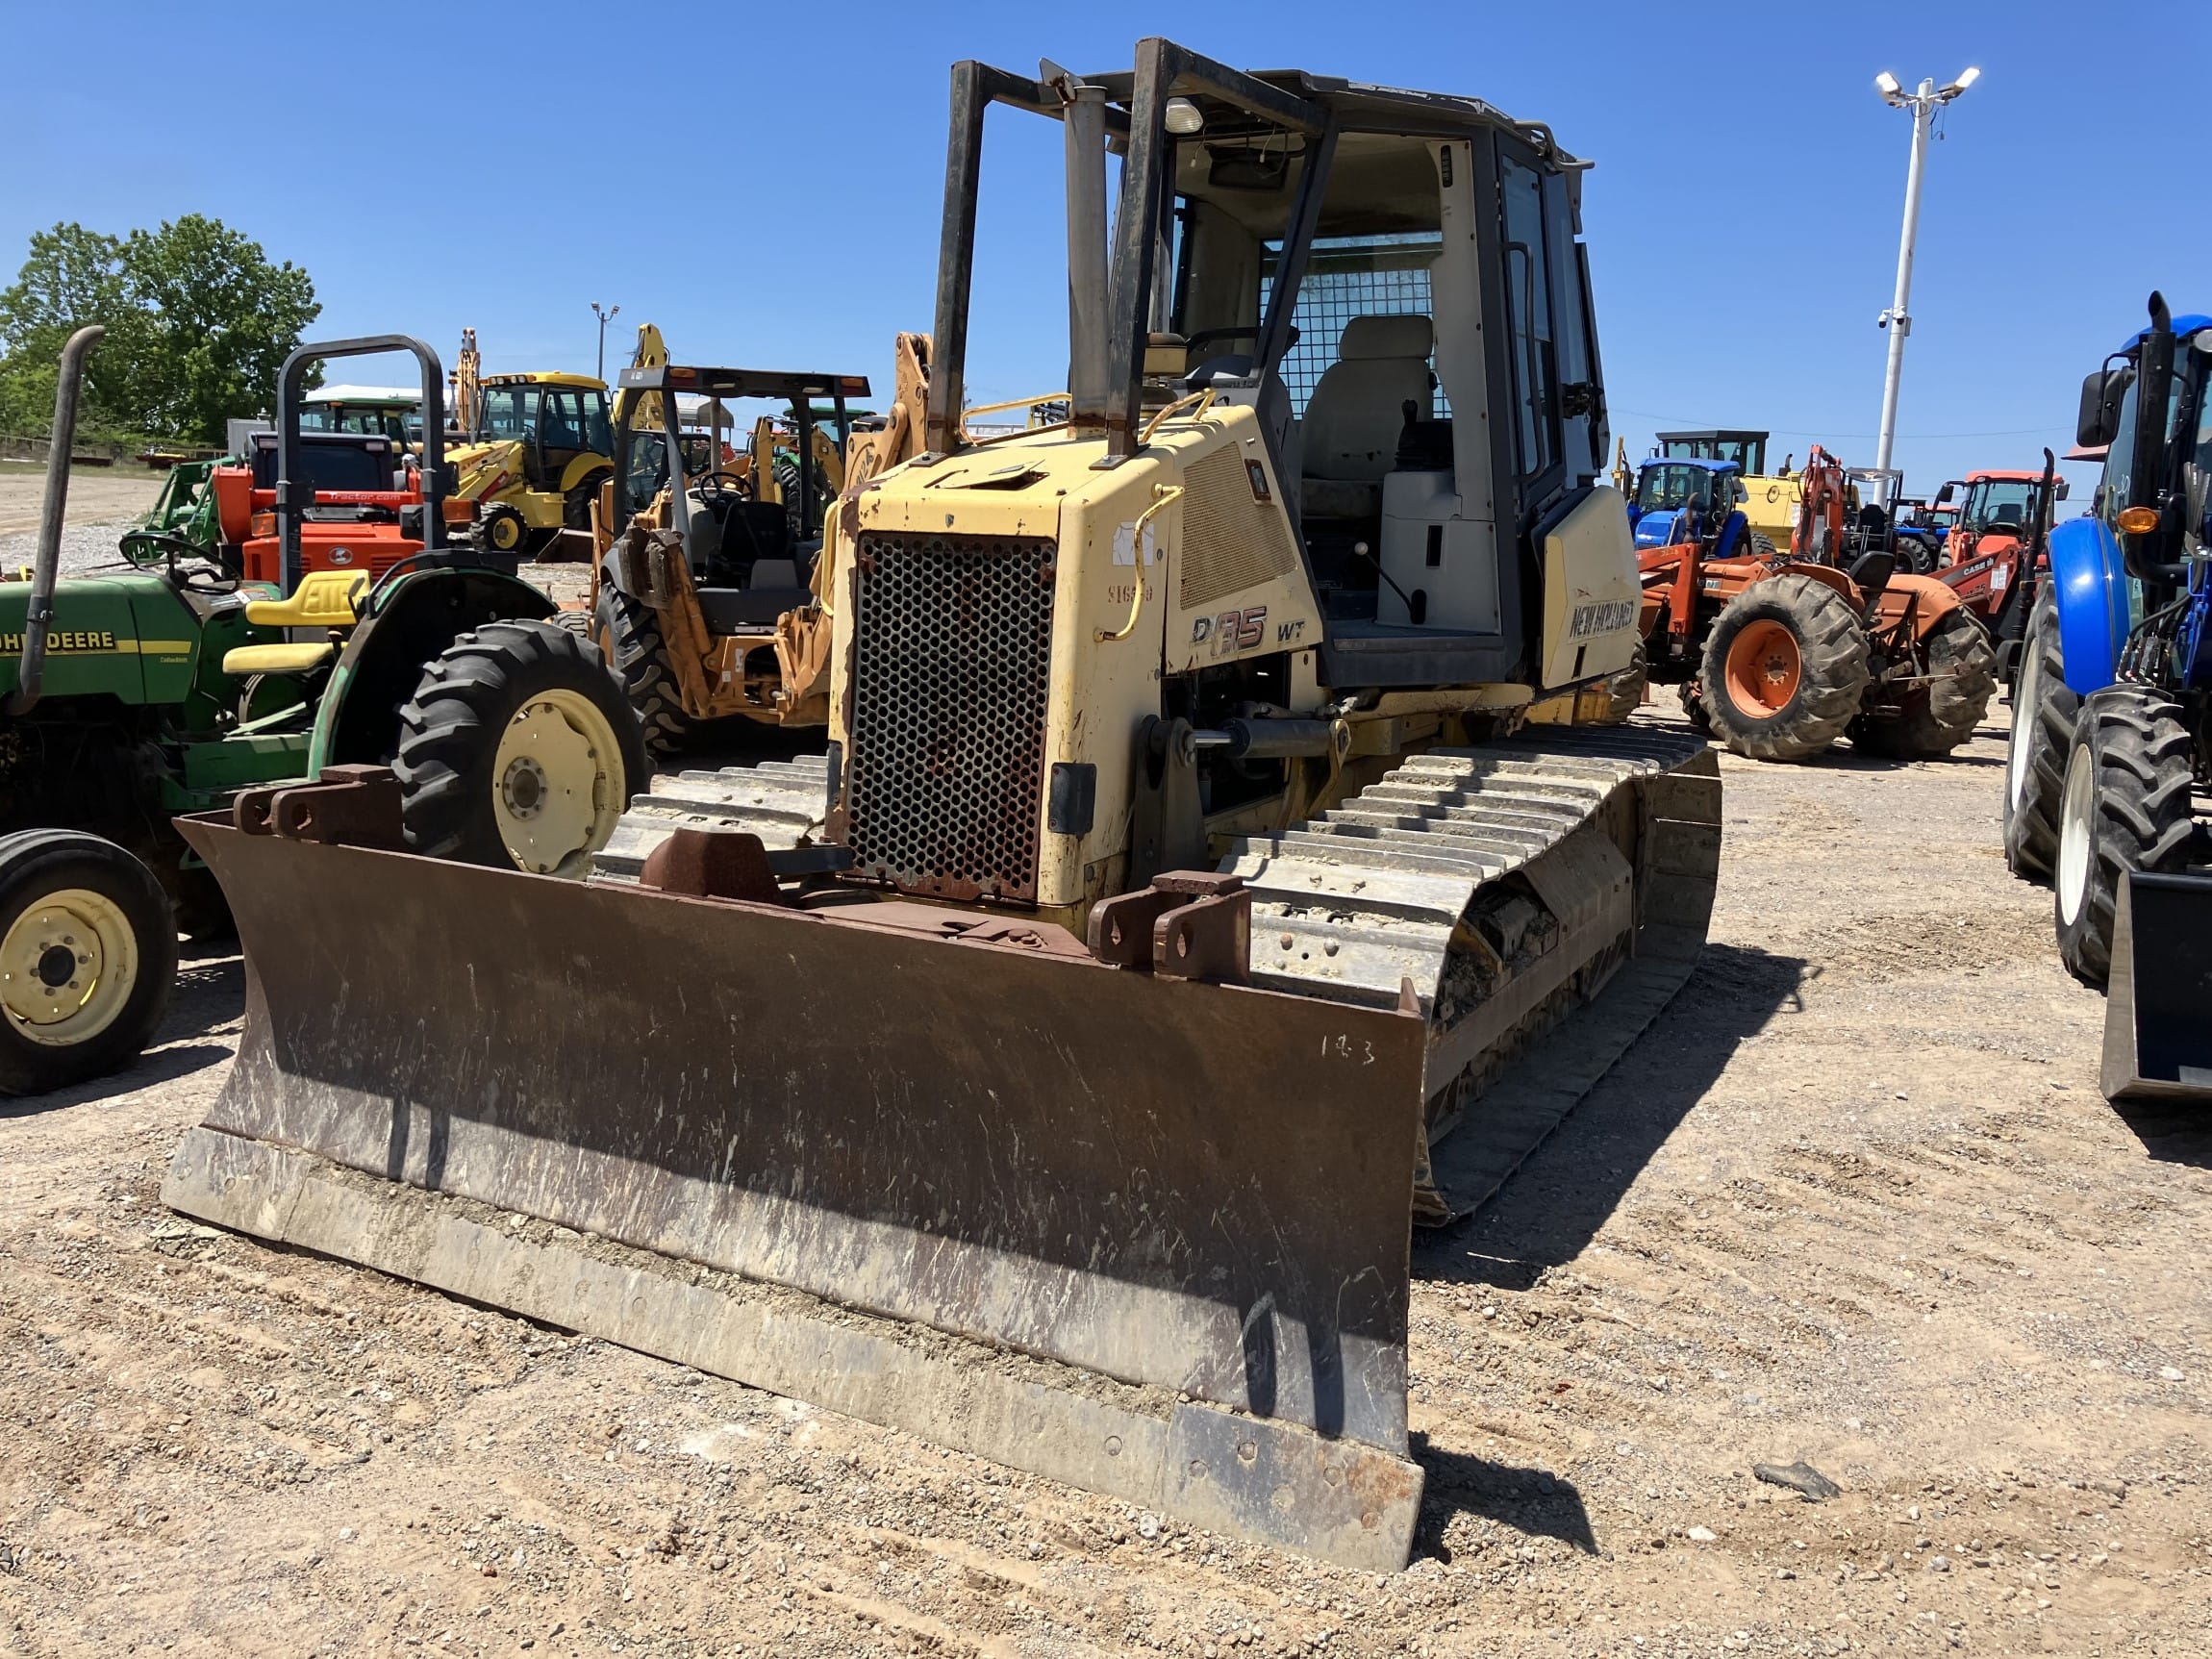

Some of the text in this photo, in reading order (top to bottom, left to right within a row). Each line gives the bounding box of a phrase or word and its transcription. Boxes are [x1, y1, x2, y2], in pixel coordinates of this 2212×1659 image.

[1963, 561, 1986, 576] CASE
[1277, 620, 1305, 641] WT
[1569, 605, 1596, 638] NEW
[47, 631, 114, 649] DEERE
